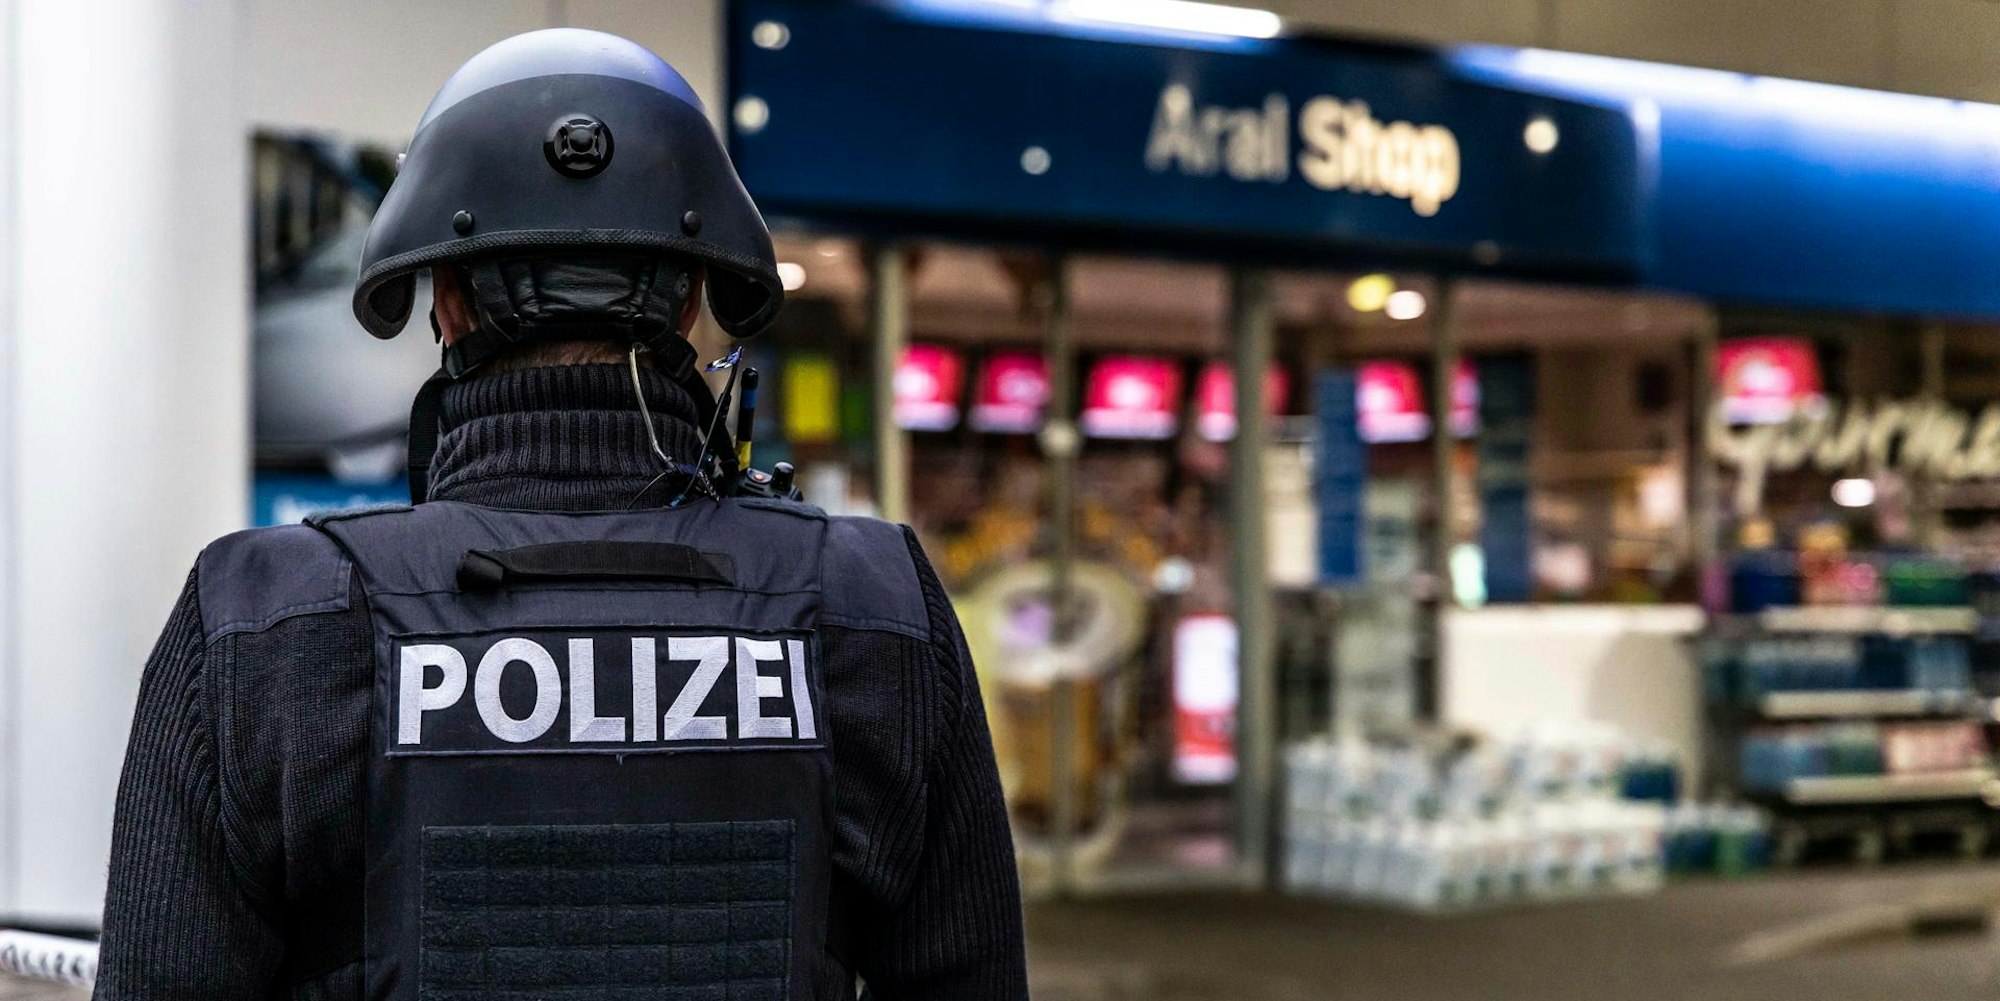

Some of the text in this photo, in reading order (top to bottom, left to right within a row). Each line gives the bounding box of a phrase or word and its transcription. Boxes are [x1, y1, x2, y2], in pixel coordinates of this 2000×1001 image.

[1145, 85, 1460, 217] Aral Shop
[398, 636, 817, 745] POLIZEI
